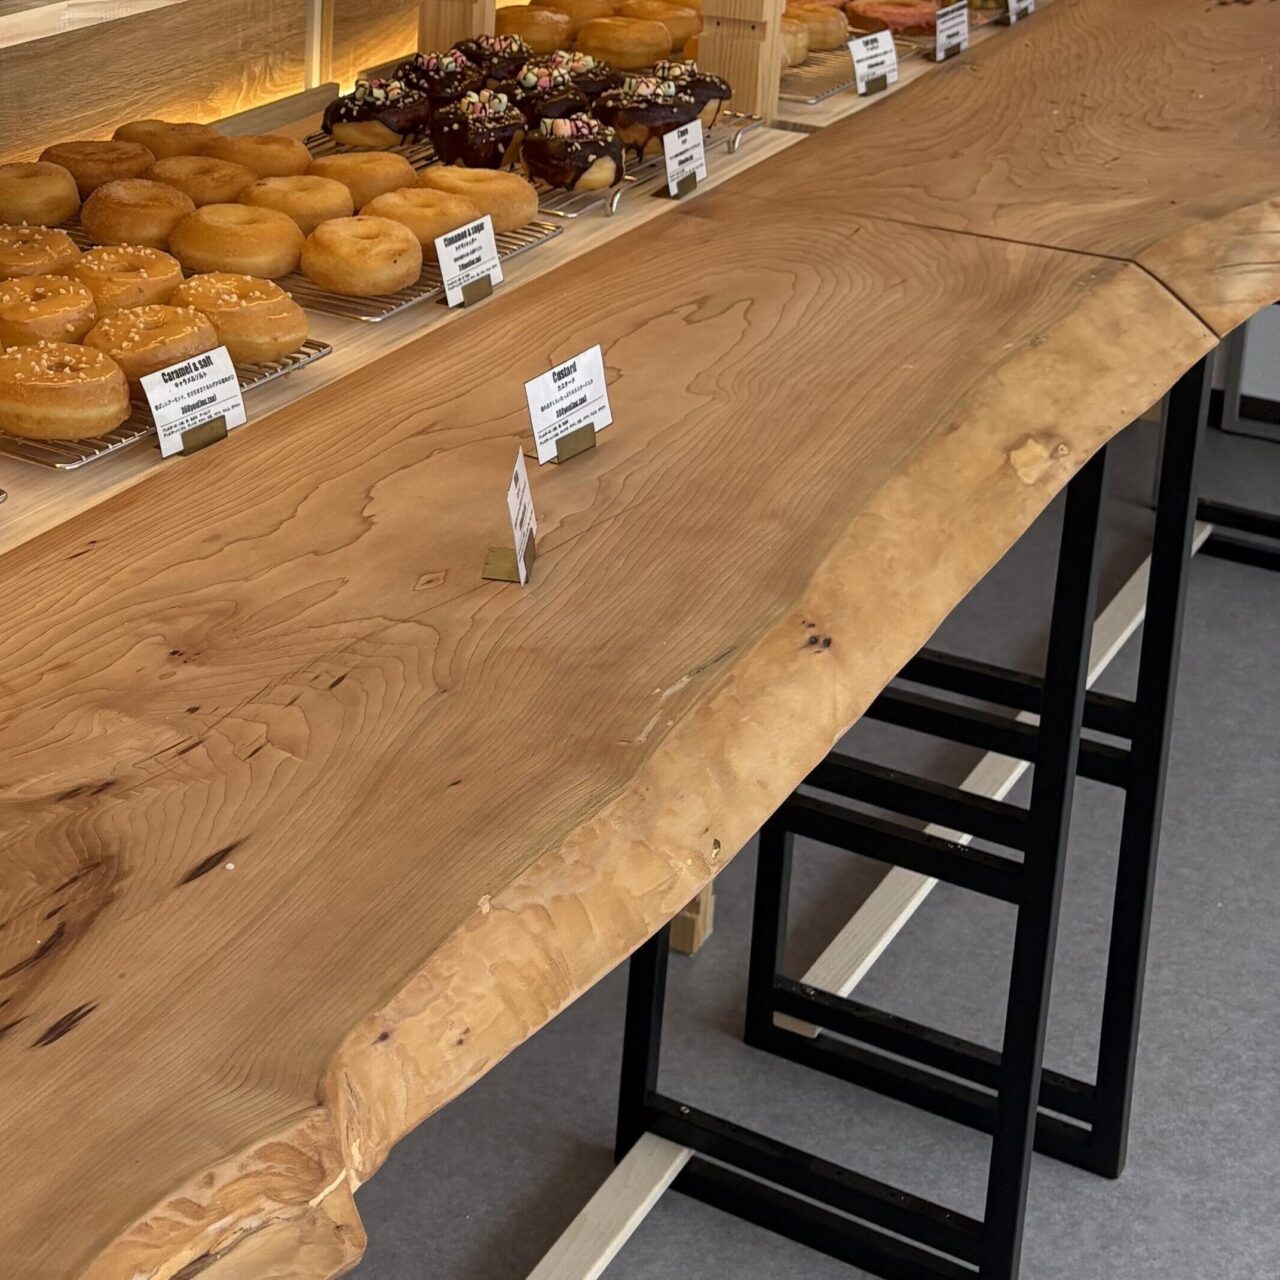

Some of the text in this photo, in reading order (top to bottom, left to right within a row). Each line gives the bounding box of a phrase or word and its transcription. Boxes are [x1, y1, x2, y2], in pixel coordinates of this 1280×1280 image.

[161, 355, 214, 384] Caramel & salt
[552, 360, 577, 383] Custard
[557, 376, 575, 392] カスタード
